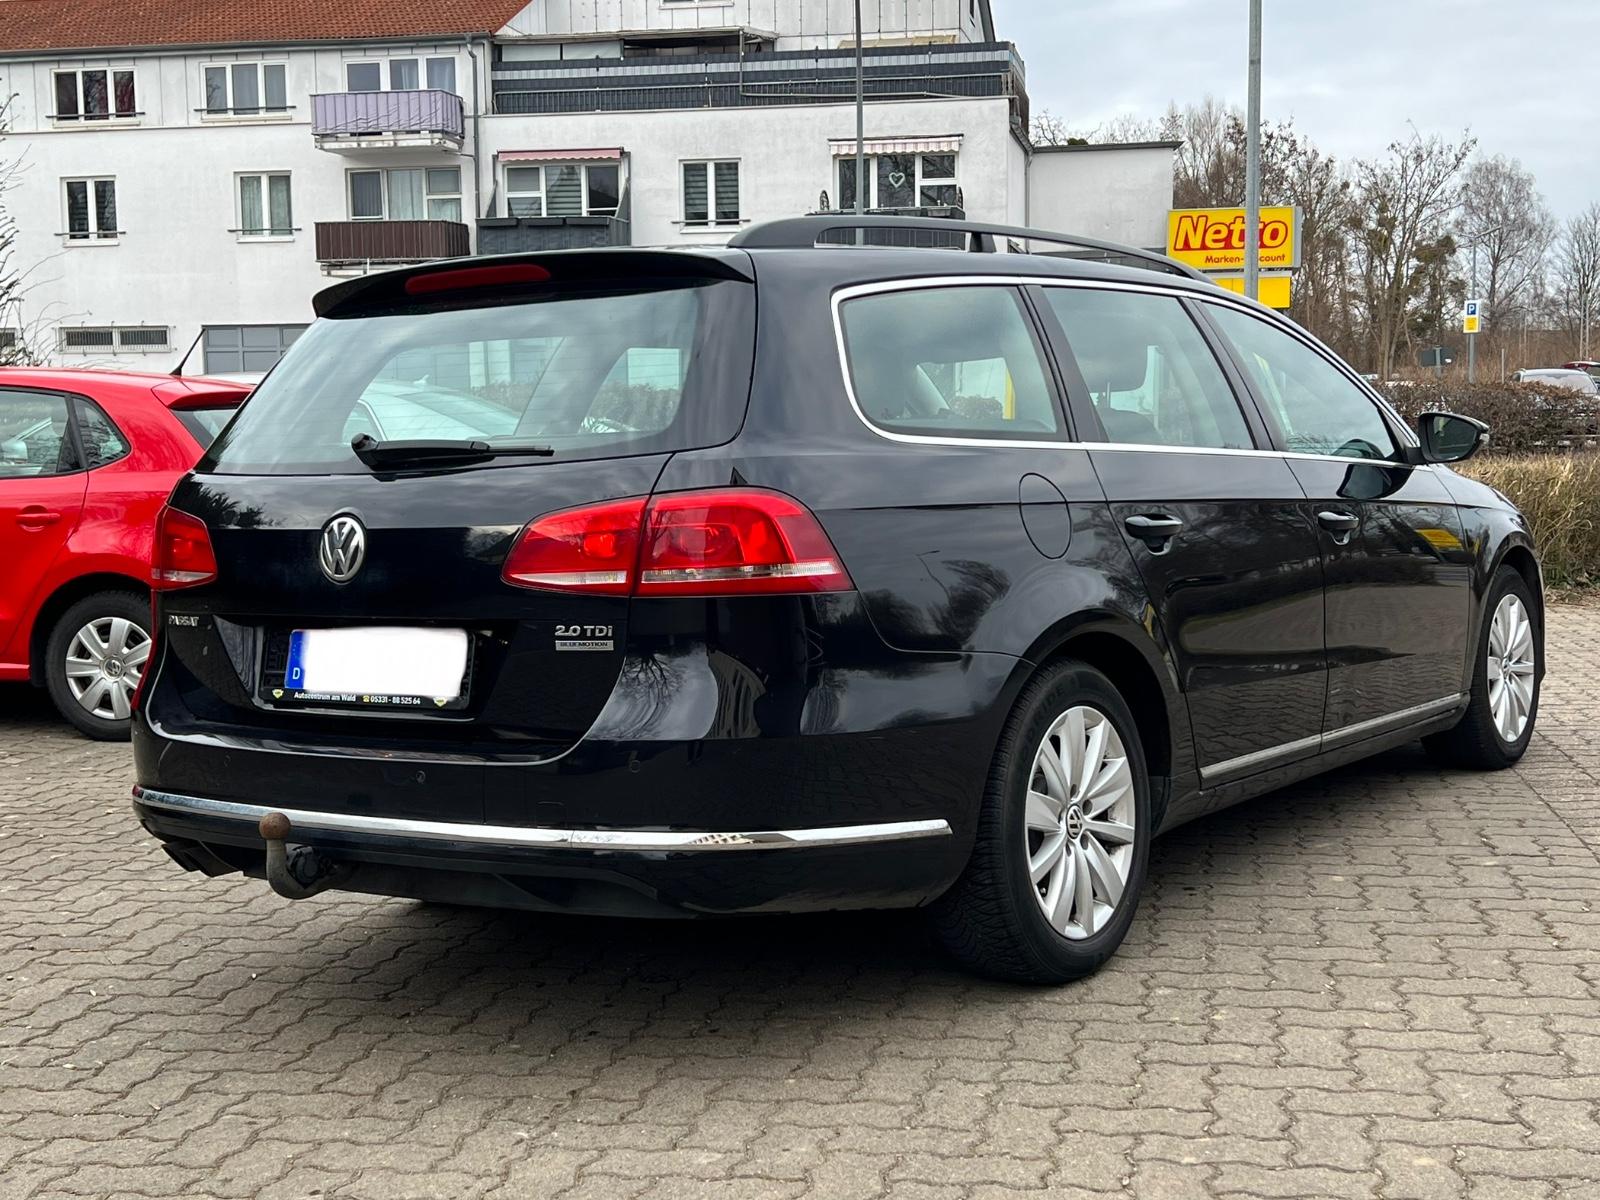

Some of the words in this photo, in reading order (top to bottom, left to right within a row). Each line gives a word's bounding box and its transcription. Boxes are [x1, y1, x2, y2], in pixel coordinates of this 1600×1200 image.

[1174, 215, 1288, 251] Neto
[1468, 304, 1475, 314] P
[293, 667, 301, 679] D
[294, 691, 331, 700] Autozentrum
[341, 694, 356, 702] Wald
[370, 695, 388, 704] 05331
